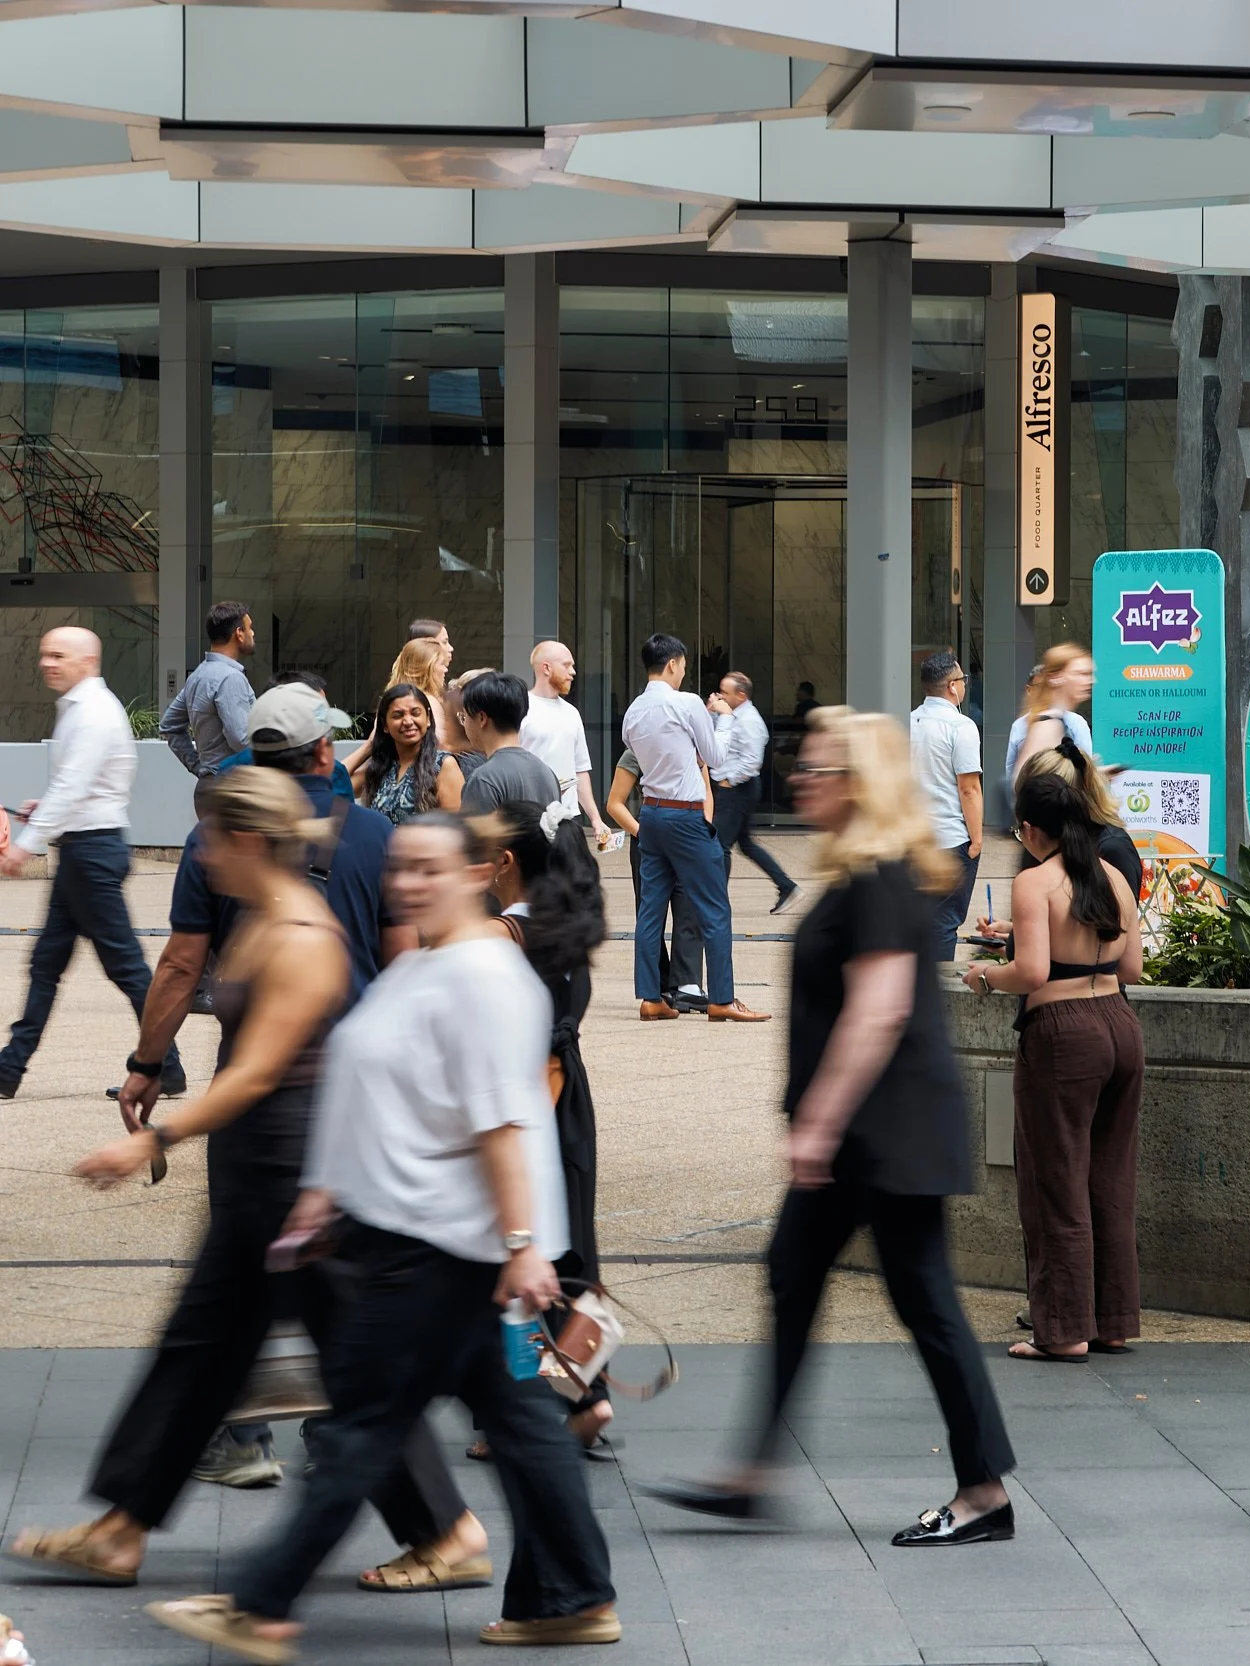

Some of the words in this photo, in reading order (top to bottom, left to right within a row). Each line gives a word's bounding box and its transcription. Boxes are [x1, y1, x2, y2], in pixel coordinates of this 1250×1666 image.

[1025, 323, 1052, 452] Alfresco
[733, 395, 818, 423] 259
[1130, 667, 1186, 678] SHAWARMA
[1109, 688, 1147, 698] CHICKEN
[1148, 688, 1161, 698] OR
[1162, 687, 1207, 697] HALLOUMI
[1163, 710, 1181, 721] FOR
[1113, 726, 1144, 738] RECIPE
[1146, 725, 1204, 738] INSPIRATION
[1133, 742, 1153, 755] AND
[1155, 741, 1187, 755] MORE!
